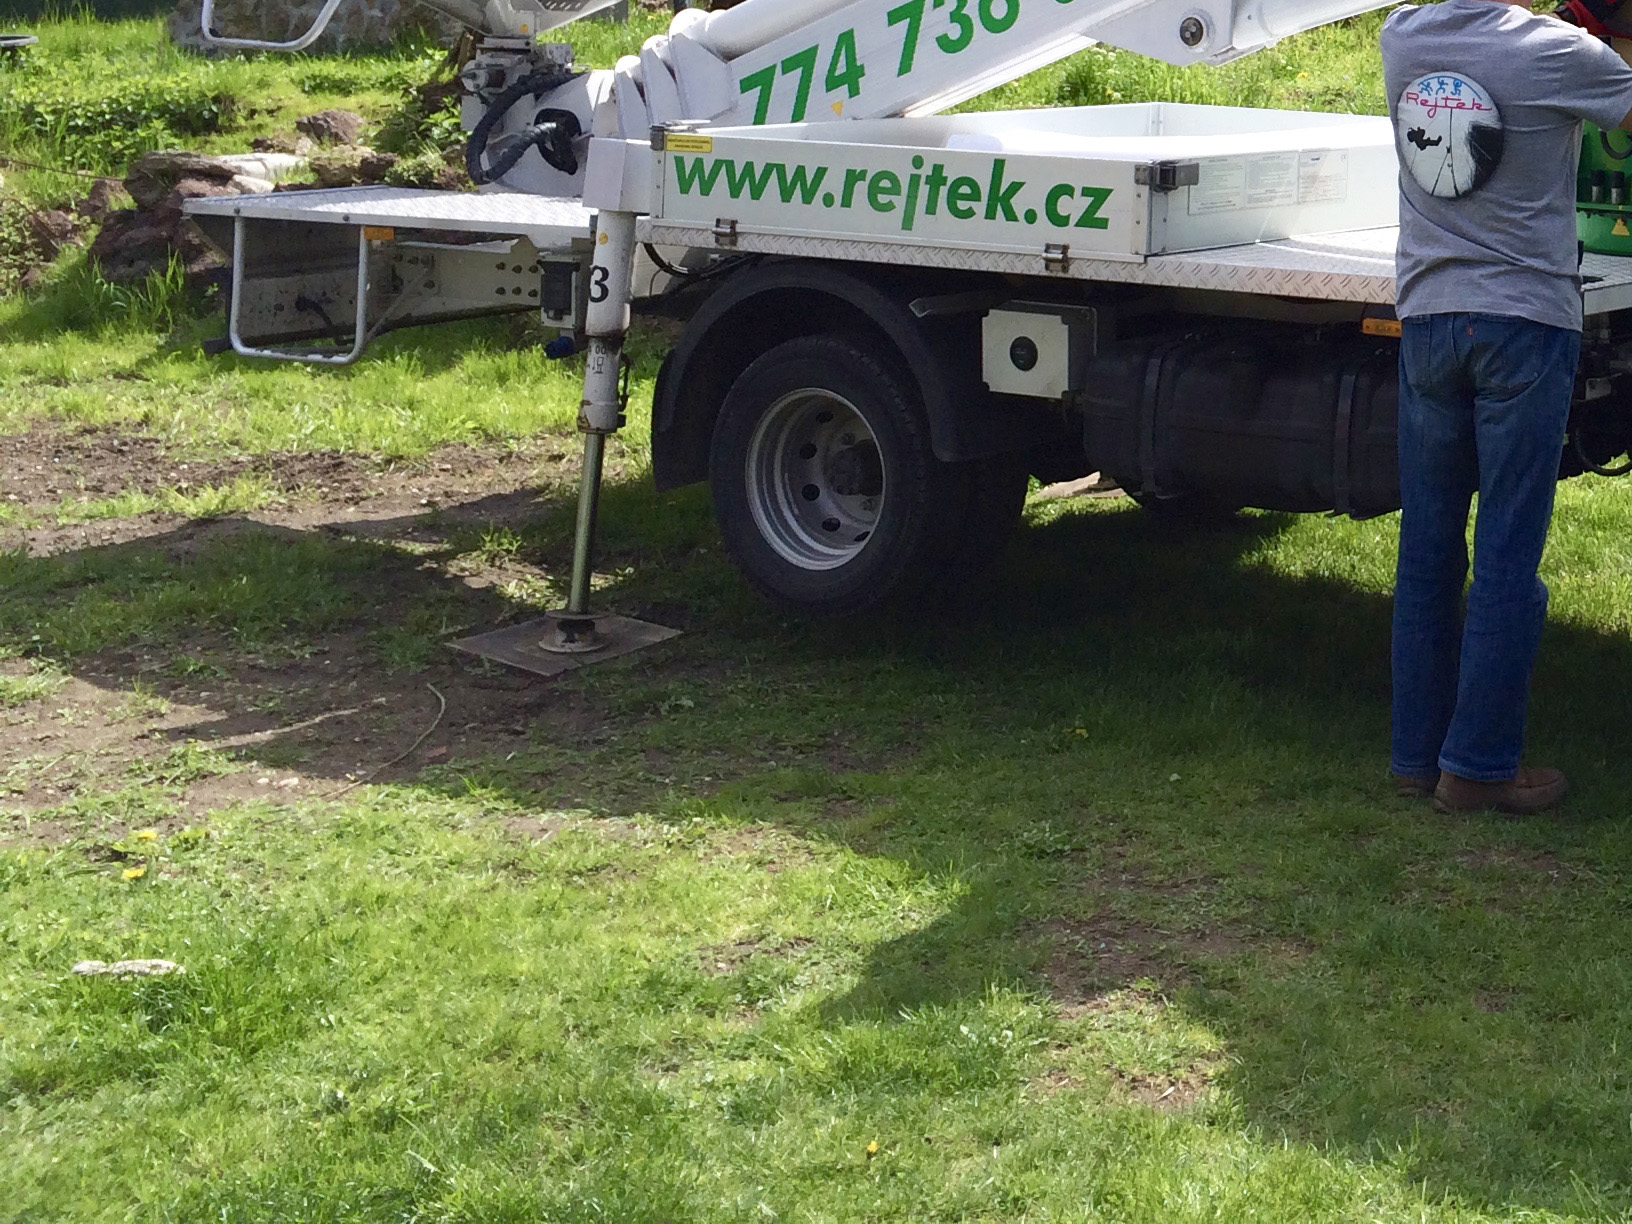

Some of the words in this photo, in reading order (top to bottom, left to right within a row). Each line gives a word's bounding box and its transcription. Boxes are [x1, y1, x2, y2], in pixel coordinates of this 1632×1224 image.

[739, 28, 866, 125] 774
[1406, 91, 1492, 118] Rejtek
[673, 155, 1115, 231] www.rejtek.cz
[590, 265, 609, 303] 3
